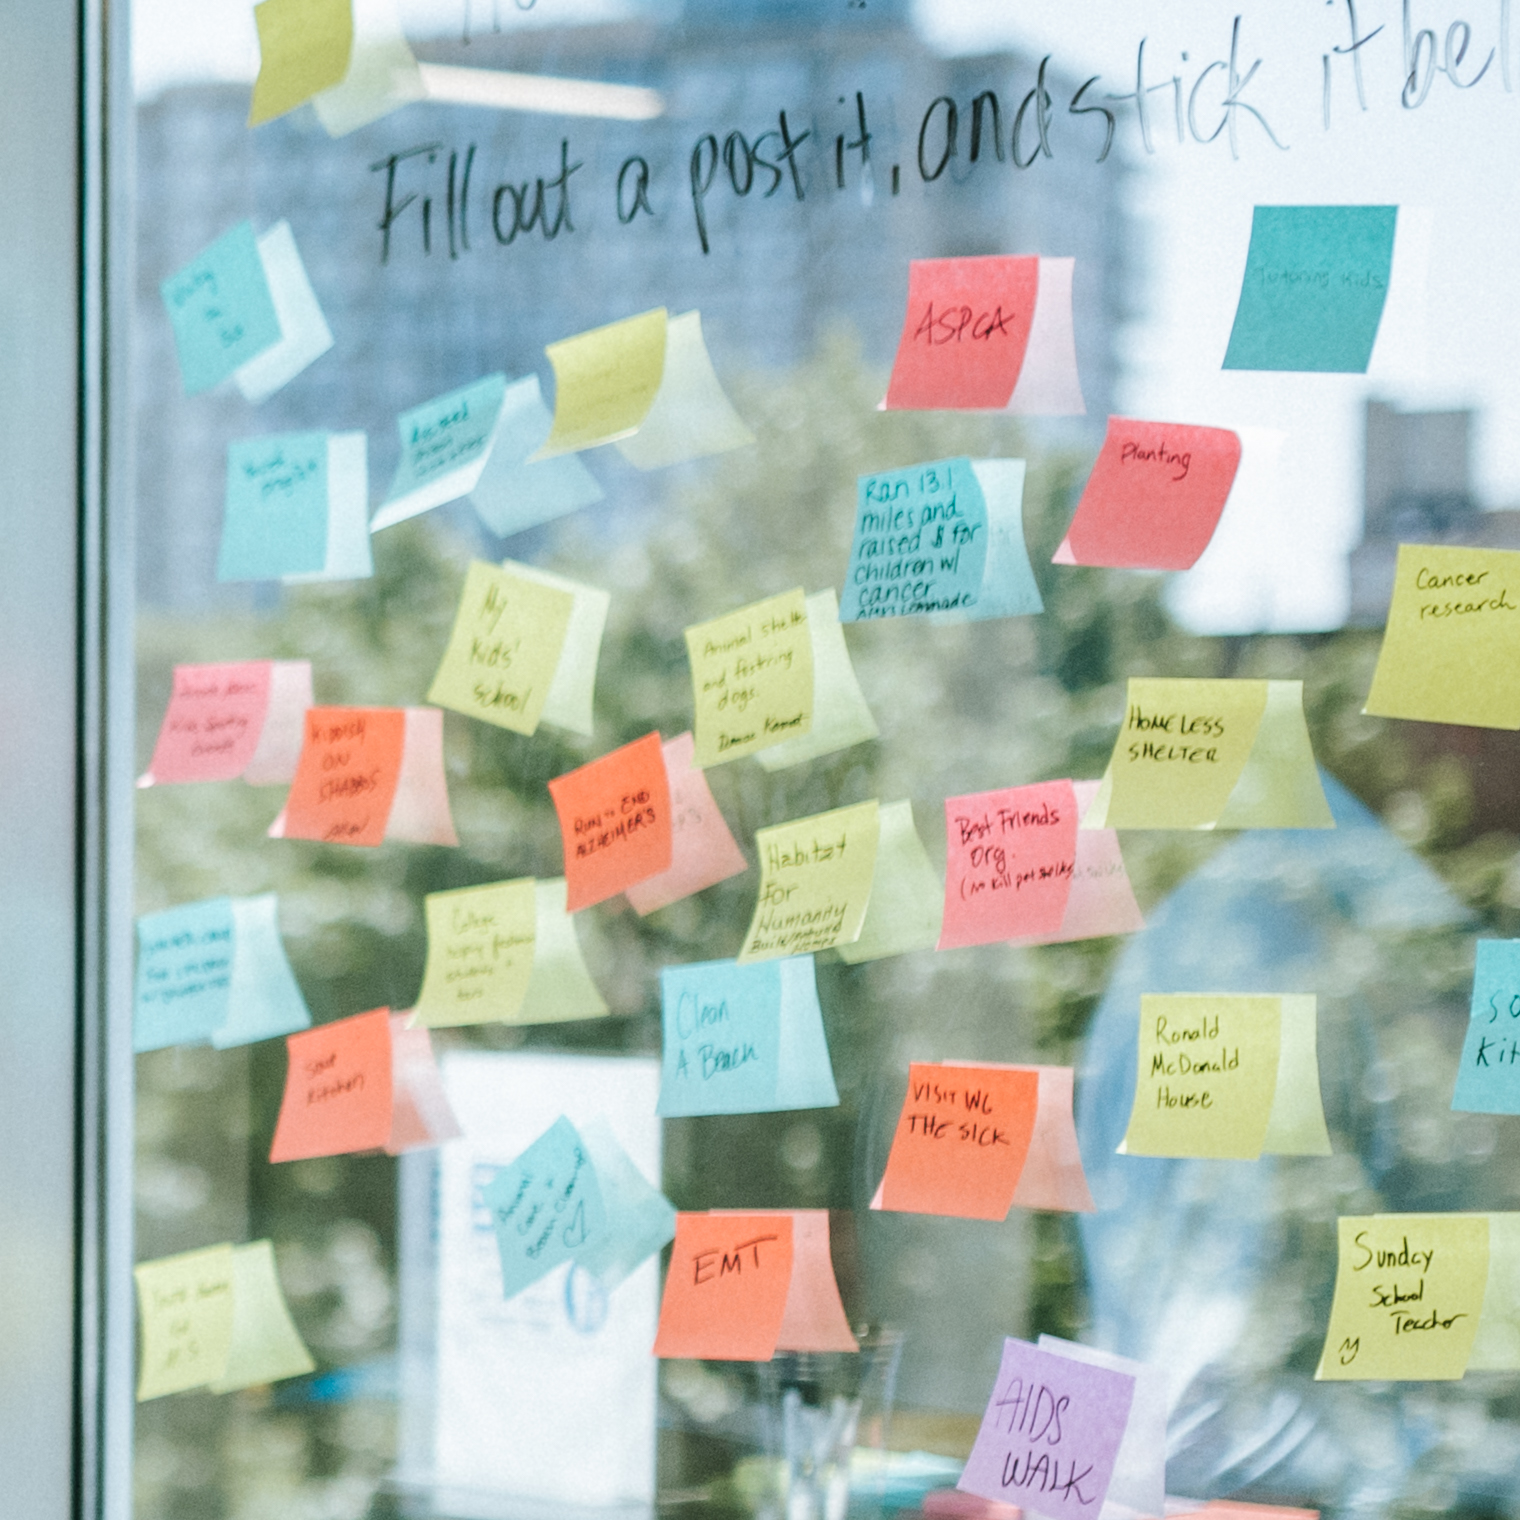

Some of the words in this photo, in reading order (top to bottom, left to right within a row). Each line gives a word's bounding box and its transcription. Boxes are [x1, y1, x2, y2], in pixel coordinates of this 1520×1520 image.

[371, 141, 476, 263] Fill
[493, 138, 584, 245] out
[617, 156, 654, 225] a
[691, 108, 813, 256] post
[835, 89, 899, 195] it,
[917, 54, 1053, 182] and
[1069, 15, 1290, 161] stick
[1323, 0, 1384, 131] it
[914, 304, 1016, 345] ASPCA
[1122, 442, 1191, 481] Planting
[866, 478, 909, 505] Ran
[861, 505, 914, 535] miles
[920, 491, 965, 527] and
[858, 528, 922, 561] raised
[932, 524, 944, 549] $
[953, 520, 982, 547] for
[854, 555, 935, 585] children
[940, 548, 959, 575] w/
[1416, 567, 1490, 590] Cancer
[859, 579, 937, 607] cancer
[1420, 589, 1517, 620] research
[704, 626, 752, 659] Animal
[703, 668, 726, 692] and
[1128, 704, 1225, 738] HOMELESS
[1128, 742, 1219, 763] SHELTER
[954, 813, 993, 846] Best
[997, 802, 1060, 834] Friends
[676, 989, 729, 1040] Clean
[1156, 1014, 1220, 1046] Ronald
[676, 1048, 691, 1081] A
[698, 1042, 759, 1081] Beach
[1150, 1046, 1240, 1078] McDonald
[1157, 1084, 1213, 1110] House
[907, 1114, 954, 1139] THE
[958, 1122, 1011, 1147] SICK
[693, 1233, 778, 1286] EMT
[1353, 1231, 1434, 1274] Sunday
[1369, 1278, 1424, 1308] School
[1390, 1309, 1469, 1335] Teacher
[995, 1376, 1070, 1446] AIDS
[1001, 1450, 1097, 1506] WALK
